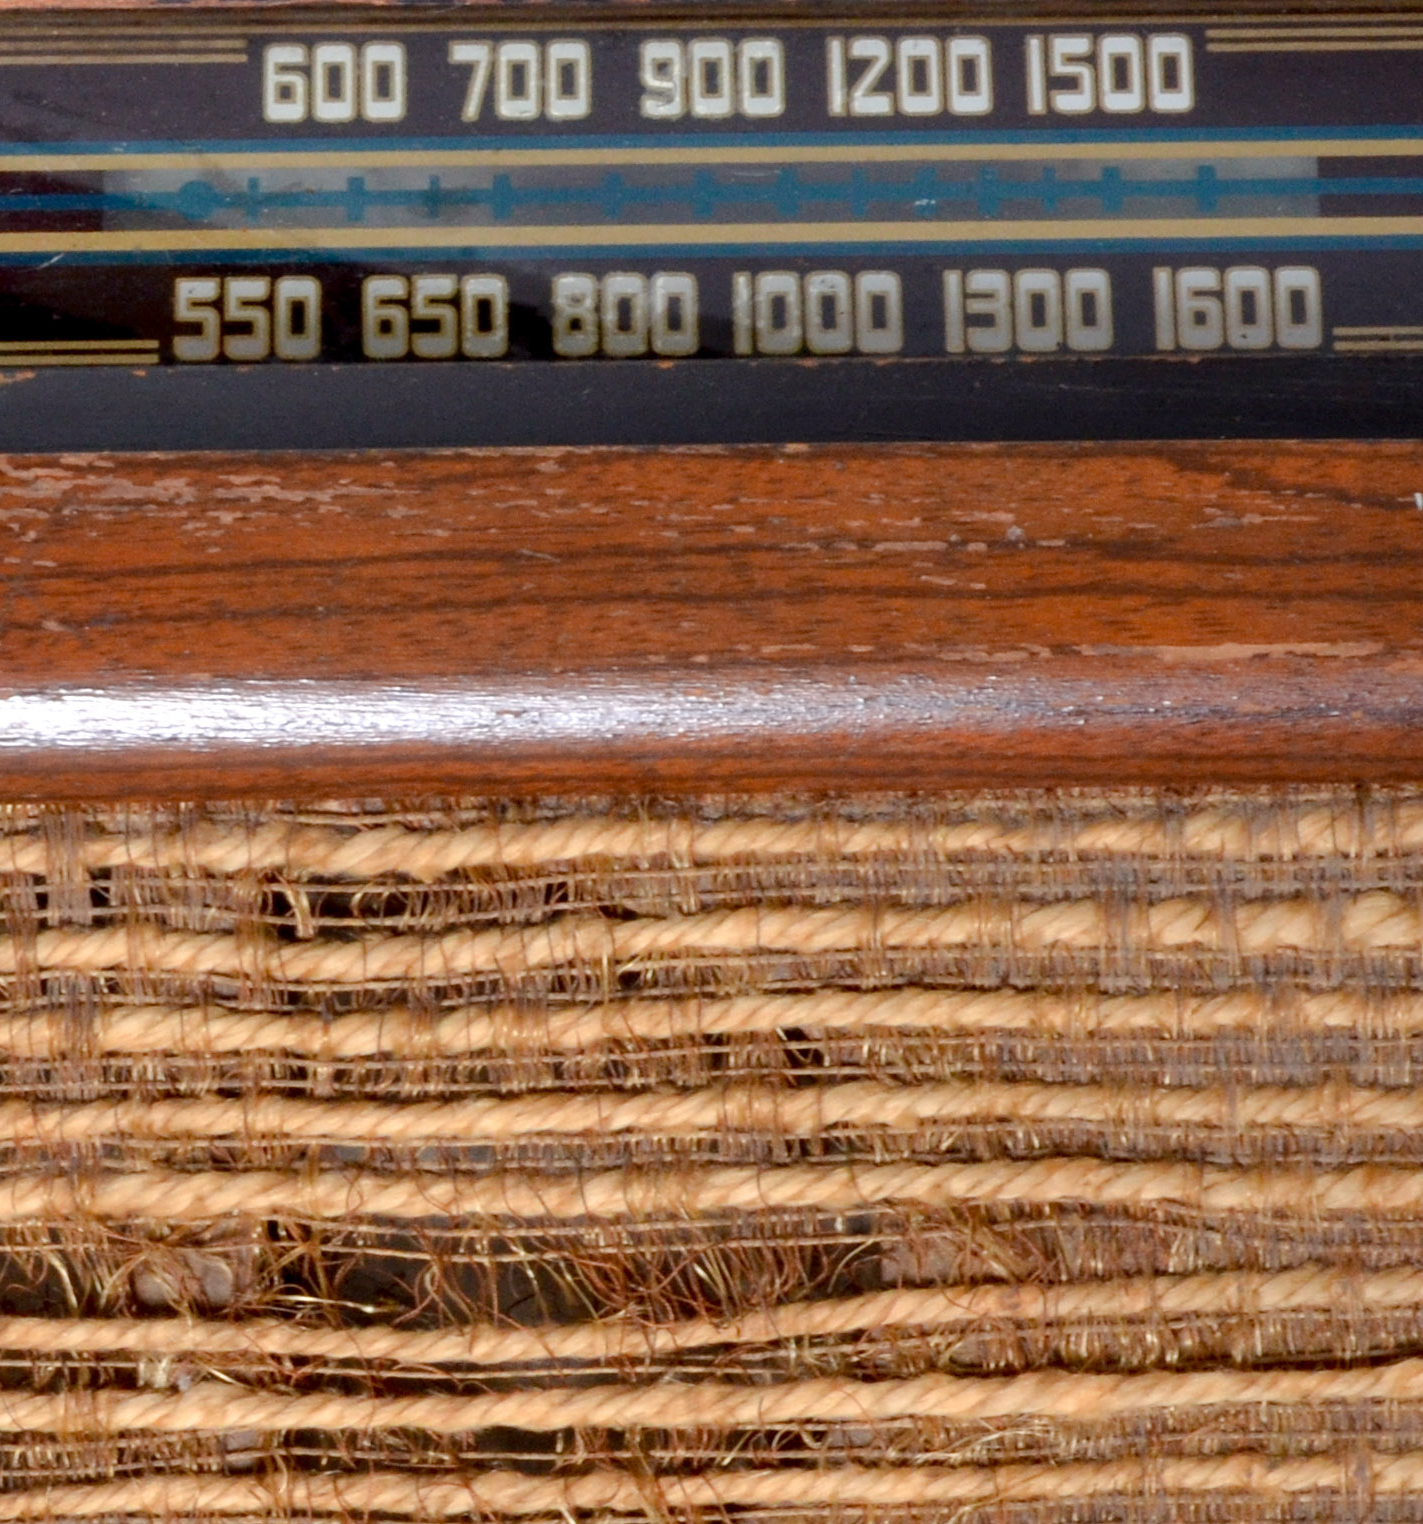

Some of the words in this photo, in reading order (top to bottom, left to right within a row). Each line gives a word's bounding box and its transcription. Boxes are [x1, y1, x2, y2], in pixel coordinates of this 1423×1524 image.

[262, 41, 407, 123] 600
[447, 39, 592, 121] 700
[638, 37, 786, 119] 900
[825, 35, 994, 117] 1200
[1025, 33, 1195, 115] 1500
[173, 275, 322, 361] 550
[362, 273, 509, 359] 650
[552, 271, 699, 357] 800
[733, 269, 903, 355] 1000
[942, 267, 1113, 353] 1300
[1153, 265, 1323, 350] 1600
